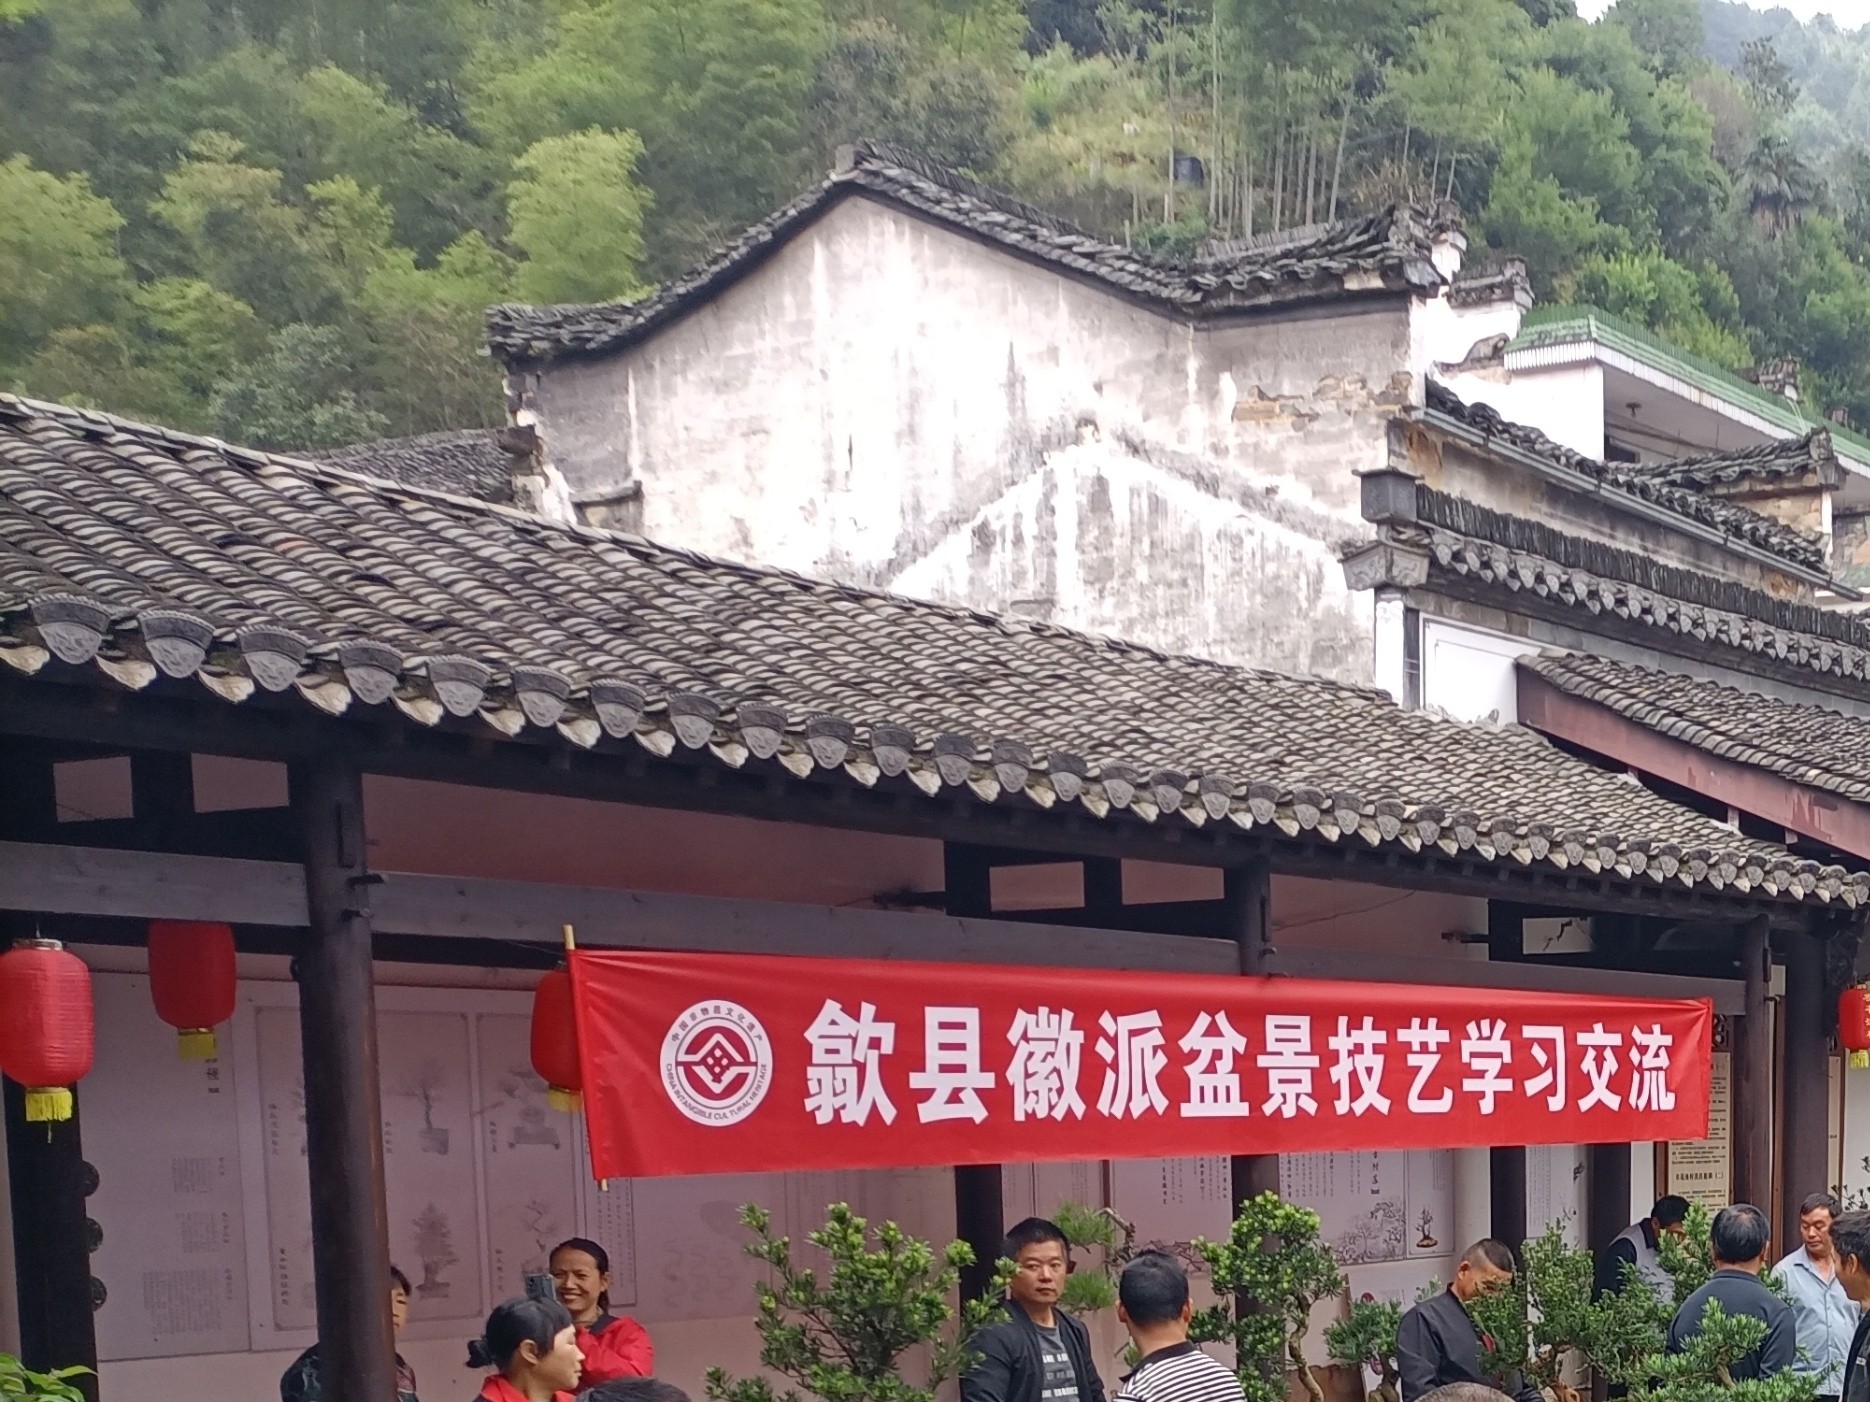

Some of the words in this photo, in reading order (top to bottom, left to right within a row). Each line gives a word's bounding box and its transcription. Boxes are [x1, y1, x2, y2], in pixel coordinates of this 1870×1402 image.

[803, 999, 1677, 1128] 歙县徽派盆景技艺学习交流
